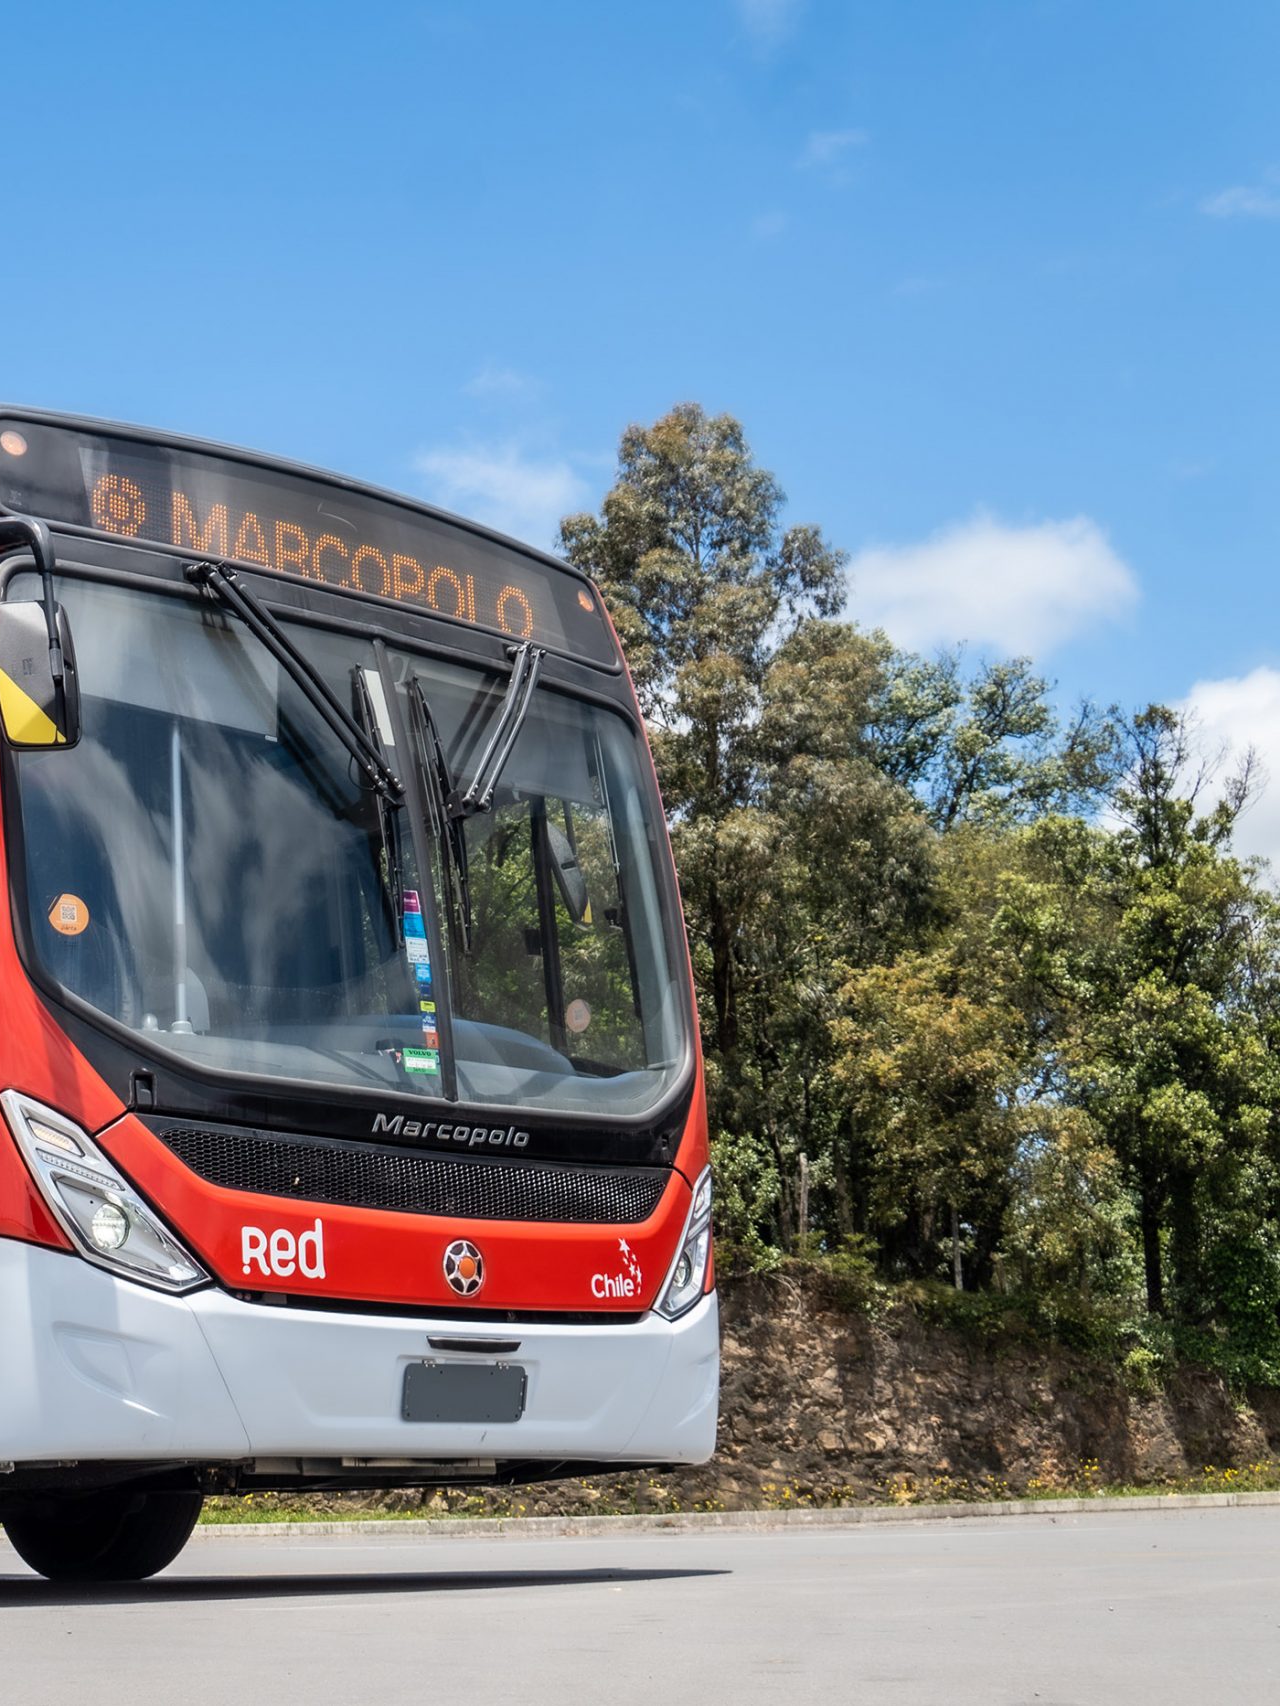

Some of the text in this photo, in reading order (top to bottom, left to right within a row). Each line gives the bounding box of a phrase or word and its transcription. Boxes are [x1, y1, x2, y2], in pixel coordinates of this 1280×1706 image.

[371, 1112, 530, 1147] Marcopolo
[241, 1217, 326, 1280] Red
[591, 1273, 634, 1298] Chile
